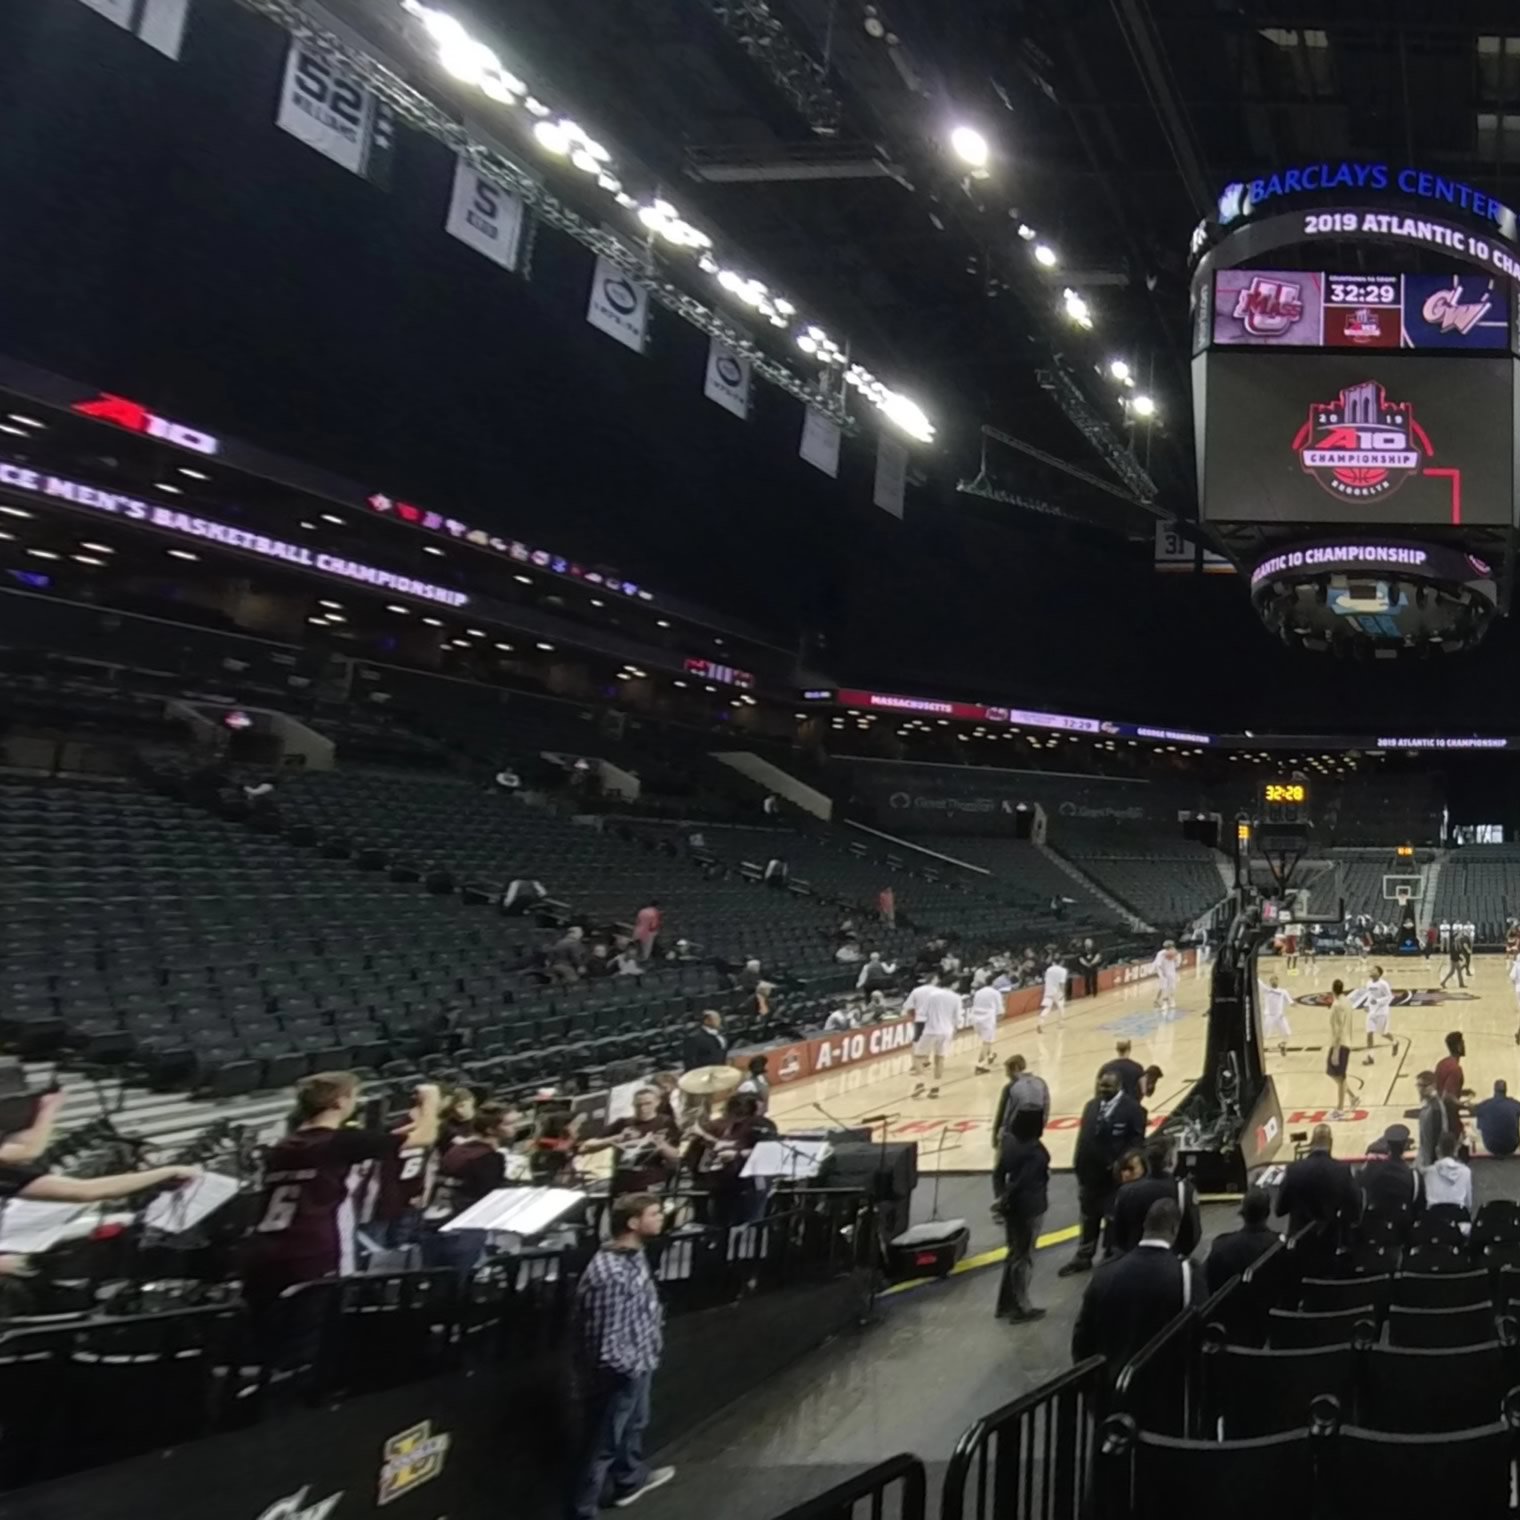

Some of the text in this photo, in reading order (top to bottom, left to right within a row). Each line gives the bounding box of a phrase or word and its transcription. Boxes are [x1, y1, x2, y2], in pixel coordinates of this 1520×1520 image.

[295, 50, 364, 127] 52
[473, 176, 499, 219] 5
[1250, 163, 1501, 222] BARCLAYS CENTER
[1303, 213, 1358, 234] 2019
[1361, 214, 1466, 251] ATLANTIC
[1468, 236, 1490, 260] 10
[1330, 284, 1395, 304] 32:29
[1315, 427, 1407, 450] A10
[1310, 453, 1411, 465] CHAMPIONSHIP
[44, 476, 147, 520] MEN'S
[150, 507, 312, 566] BASKETBALL
[316, 553, 468, 606] CHAMPIONSHIP
[1288, 551, 1303, 567] 10
[1305, 546, 1427, 566] CHAMPIONSHIP
[870, 695, 952, 714] MASSACHUSETTS
[1397, 738, 1435, 748] ATLANTIC
[1446, 738, 1508, 748] CHAMPIONSHIP
[1265, 785, 1304, 801] 32:28
[815, 1034, 865, 1071] A-10
[257, 1185, 301, 1233] 6
